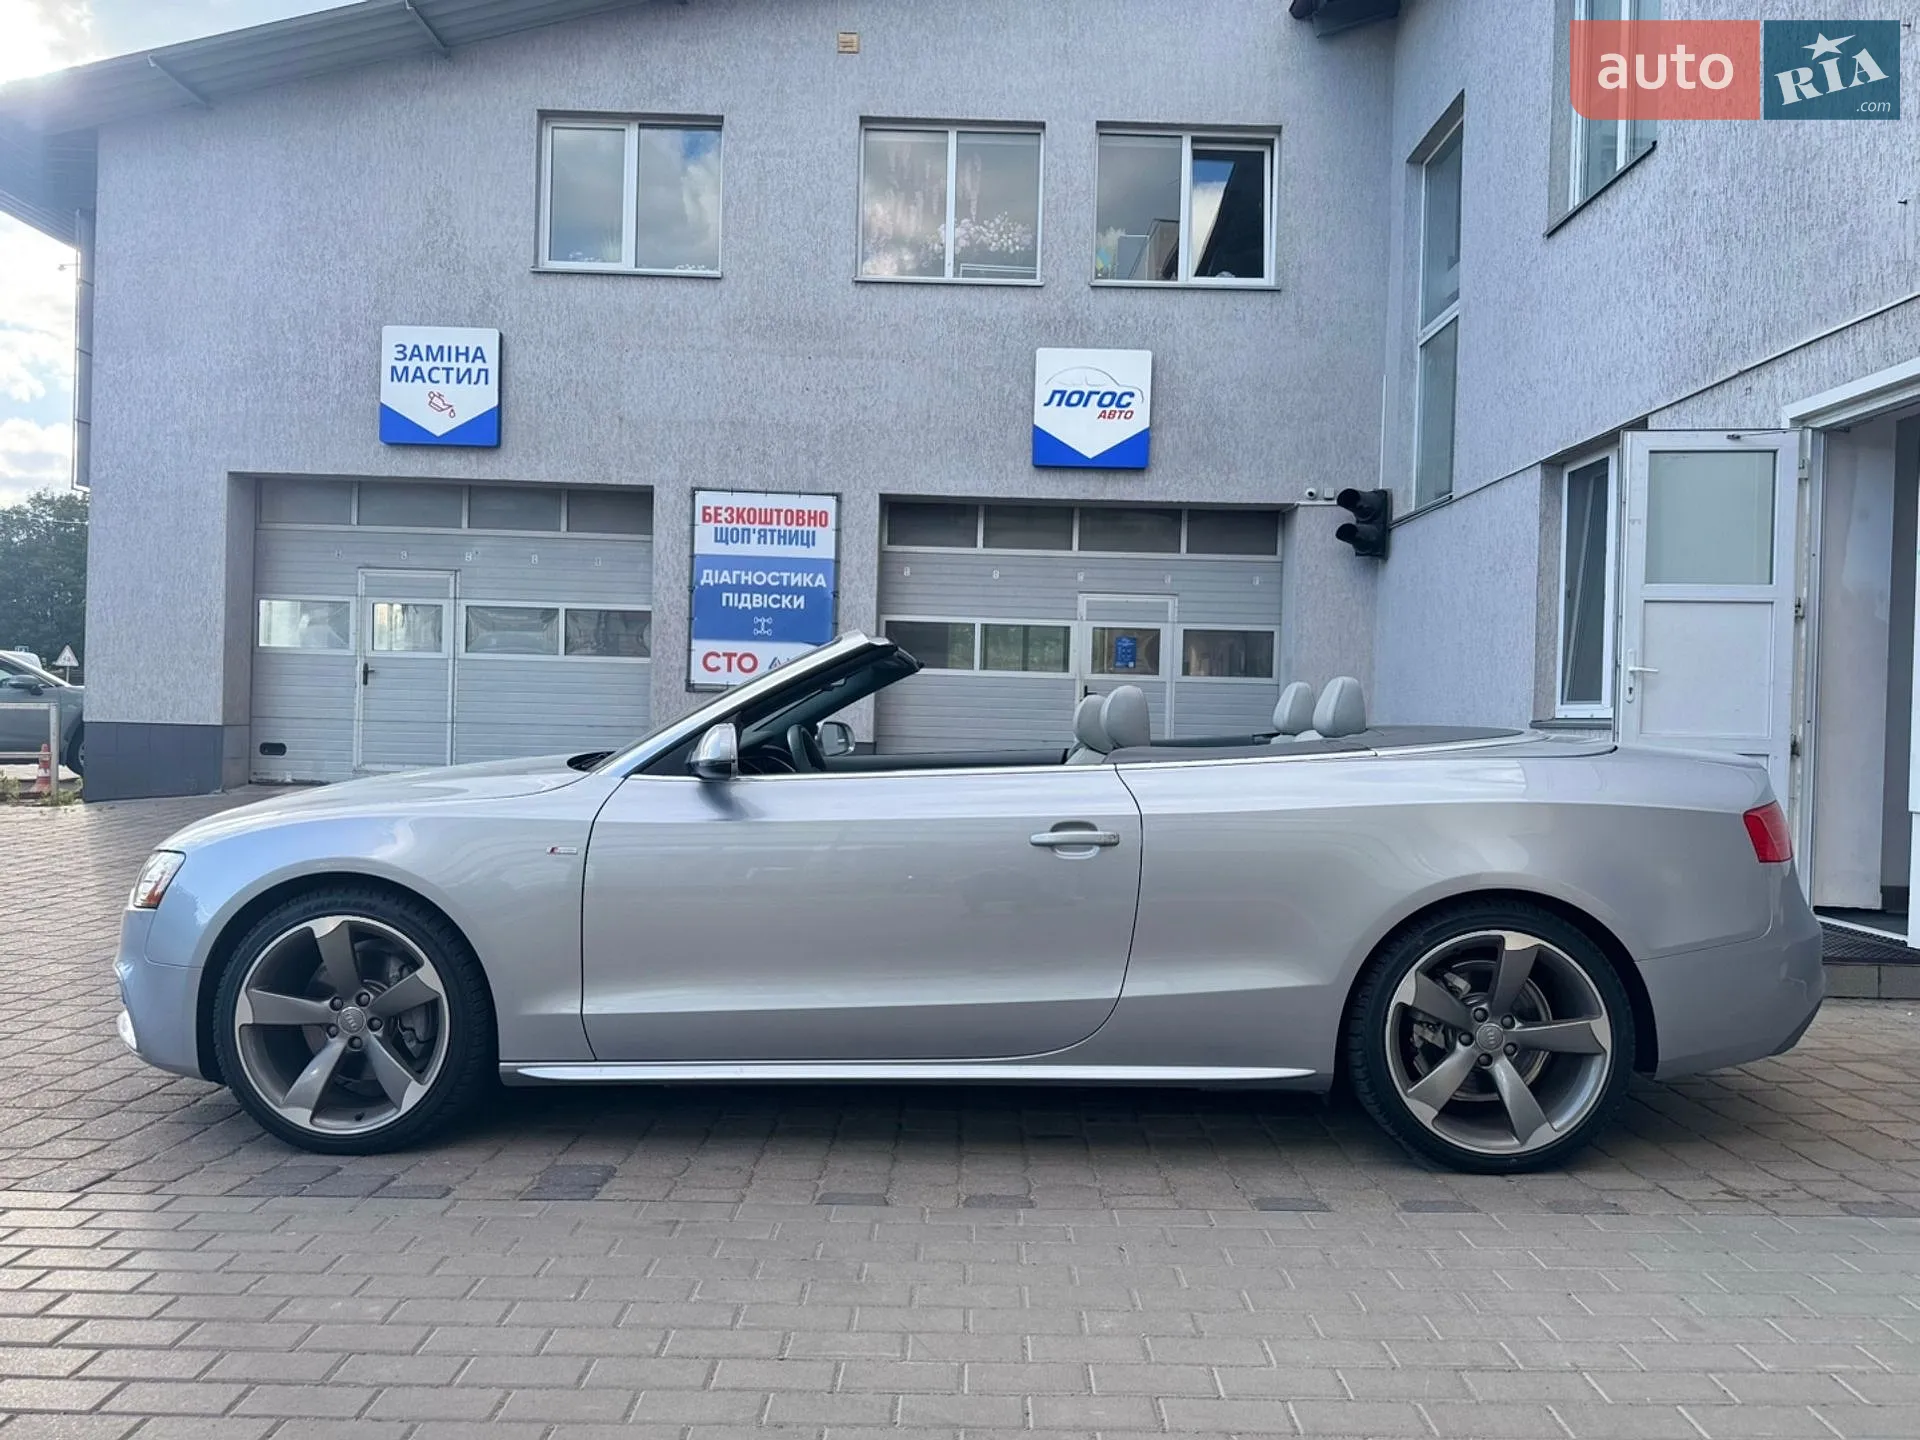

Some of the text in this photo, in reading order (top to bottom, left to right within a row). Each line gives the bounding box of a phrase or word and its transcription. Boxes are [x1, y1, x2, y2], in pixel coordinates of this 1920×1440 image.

[393, 343, 487, 364] ЗАМІНА
[390, 365, 489, 386] МАСТИЛ
[1042, 389, 1135, 409] ЛОГОС
[1097, 409, 1134, 421] АВТО
[701, 505, 829, 528] БЕЗКОШТОВНО
[713, 526, 816, 548] ЩОП'ЯТНИЦІ
[700, 569, 827, 588] ДІАГНОСТИКА
[721, 592, 805, 610] ПІДВІСКИ
[702, 651, 759, 674] СТО
